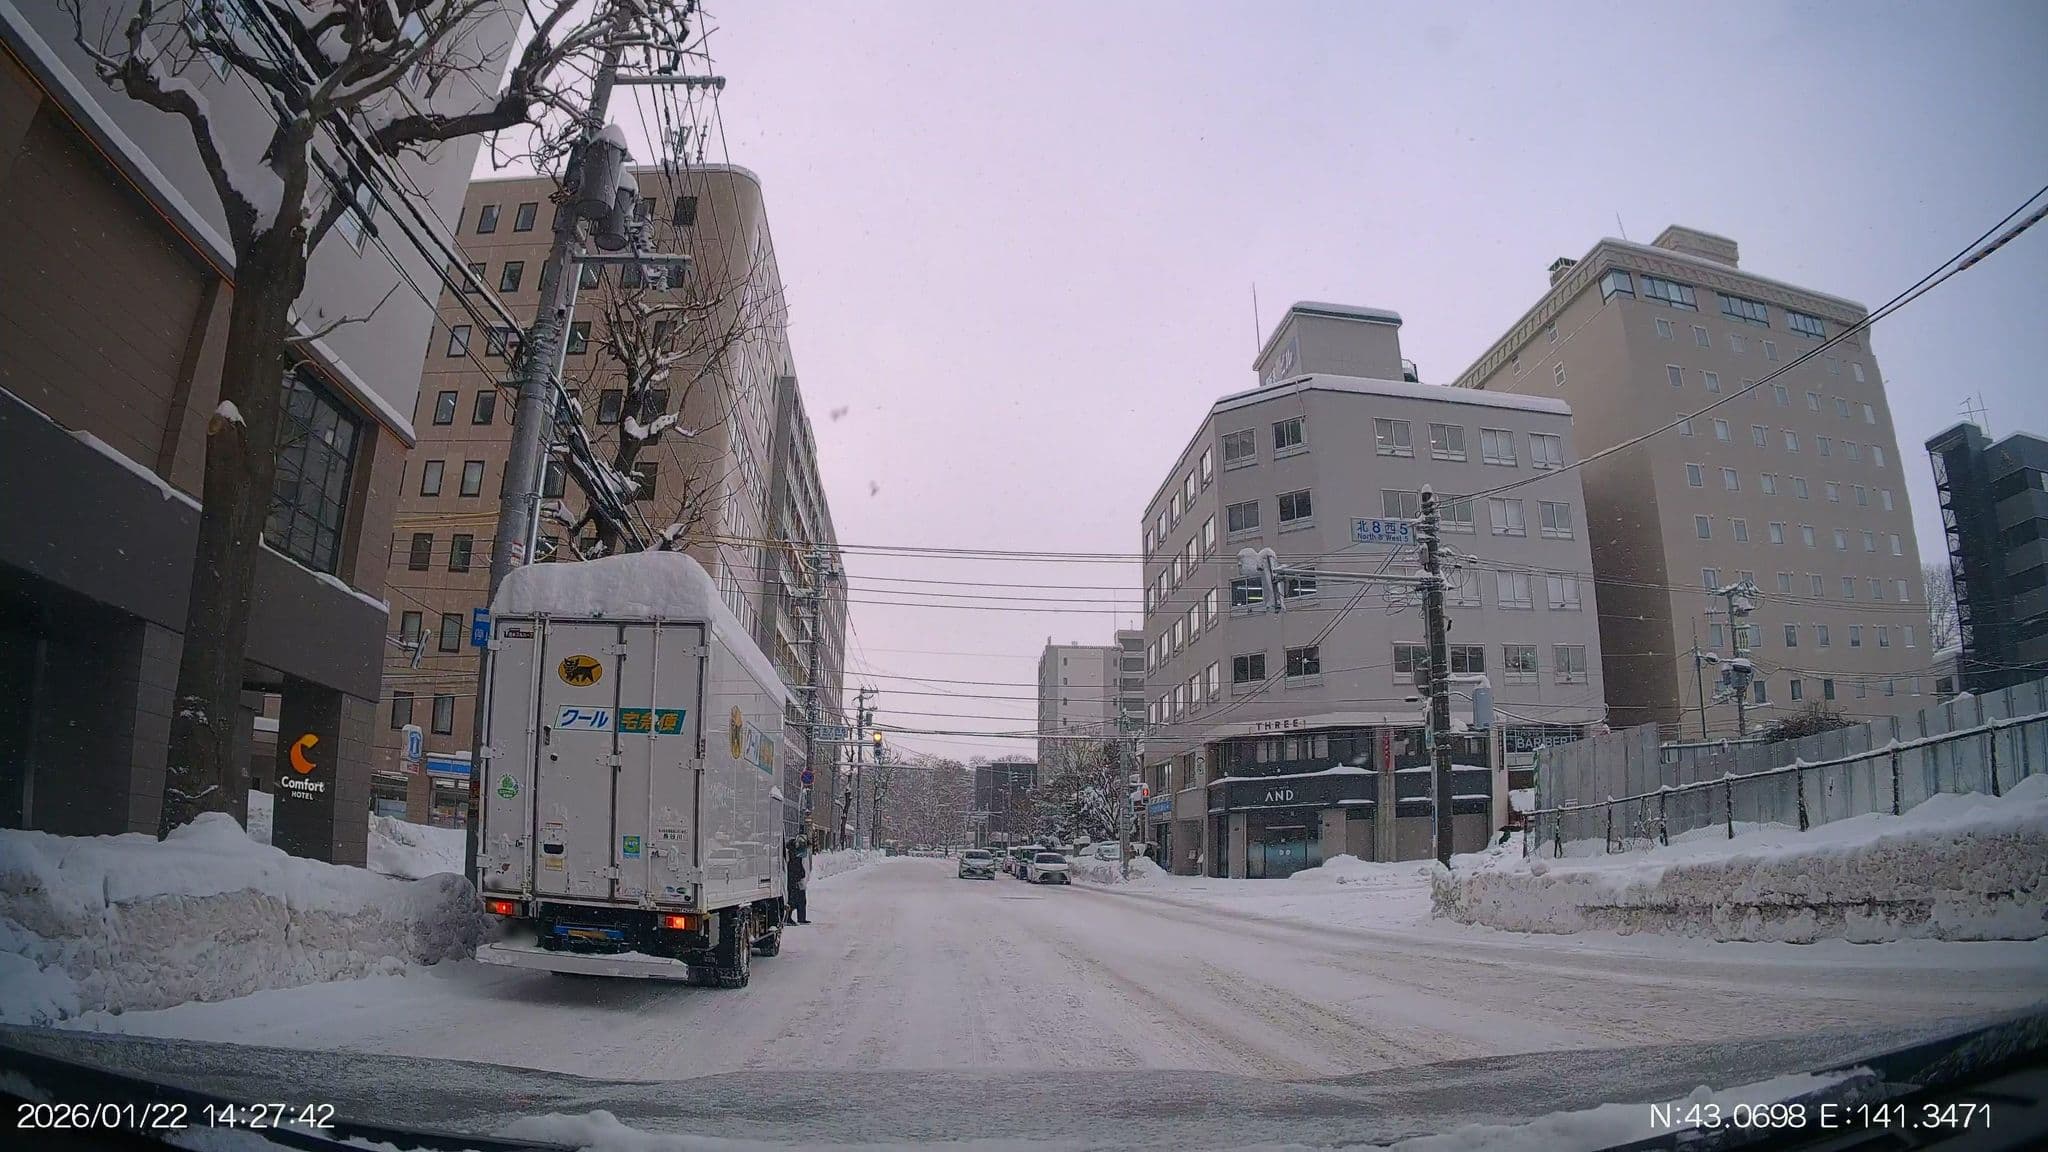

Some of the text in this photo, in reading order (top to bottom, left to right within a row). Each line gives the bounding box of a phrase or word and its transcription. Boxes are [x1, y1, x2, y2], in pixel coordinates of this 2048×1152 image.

[1357, 533, 1377, 541] North
[561, 709, 609, 728] クール
[1256, 719, 1299, 731] THREE
[281, 776, 325, 793] Comfort
[291, 791, 314, 800] HOTEL
[1265, 789, 1294, 801] AND
